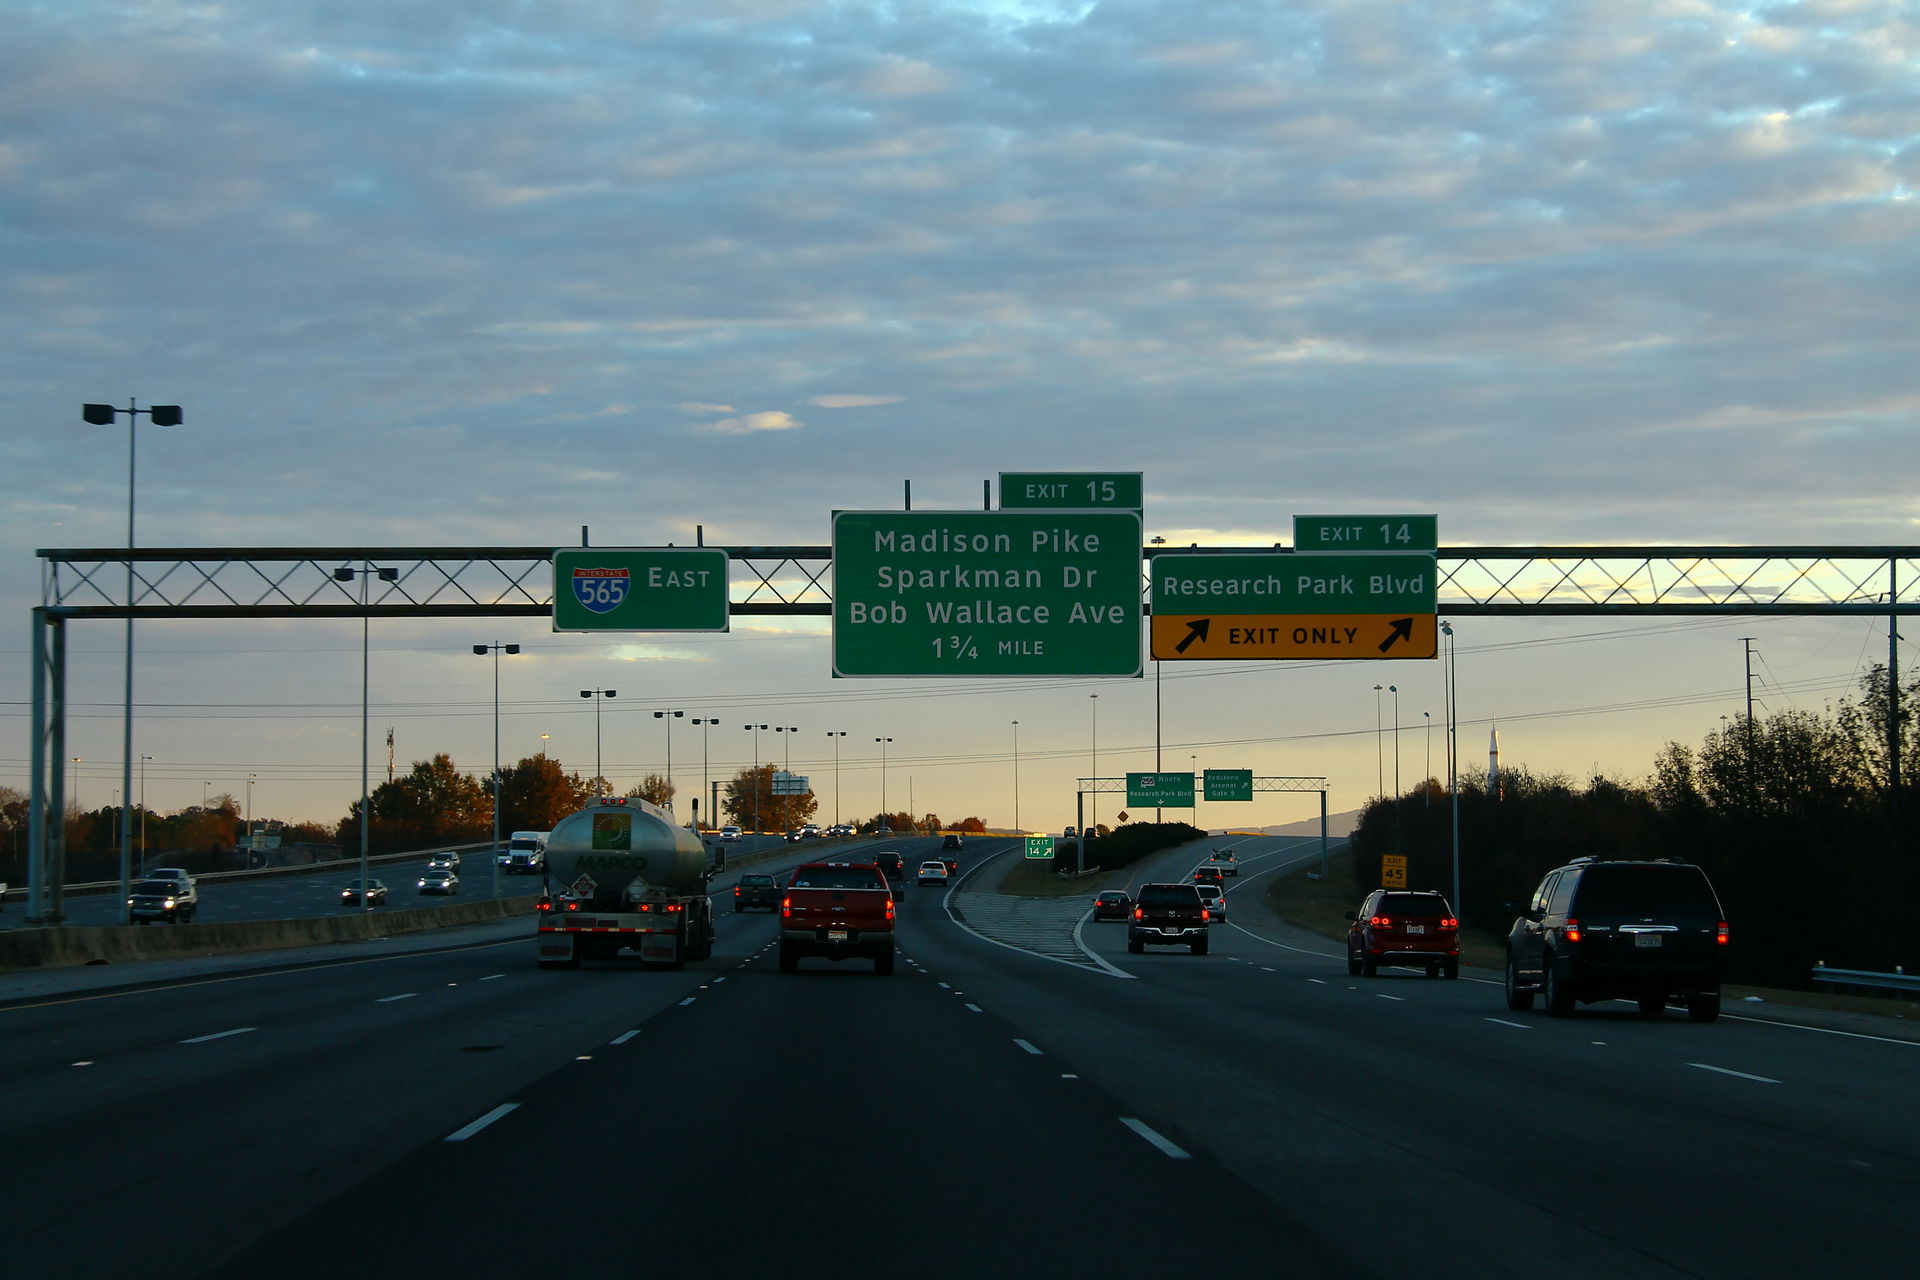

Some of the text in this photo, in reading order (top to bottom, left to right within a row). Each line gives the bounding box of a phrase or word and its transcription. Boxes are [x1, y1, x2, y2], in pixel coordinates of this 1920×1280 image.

[1026, 481, 1115, 501] EXIT 15
[874, 529, 1100, 552] Madison Pike
[1320, 523, 1411, 544] EXIT 14
[878, 565, 1098, 594] Sparkman Dr
[1164, 574, 1424, 595] Research Park Blvd
[582, 579, 624, 604] 565
[850, 600, 1125, 624] Bob Wallace Ave
[1229, 627, 1358, 645] EXIT ONLY
[998, 641, 1044, 655] MILE
[1141, 777, 1155, 785] 255
[575, 855, 648, 872] MAPCO
[1385, 869, 1403, 879] 45
